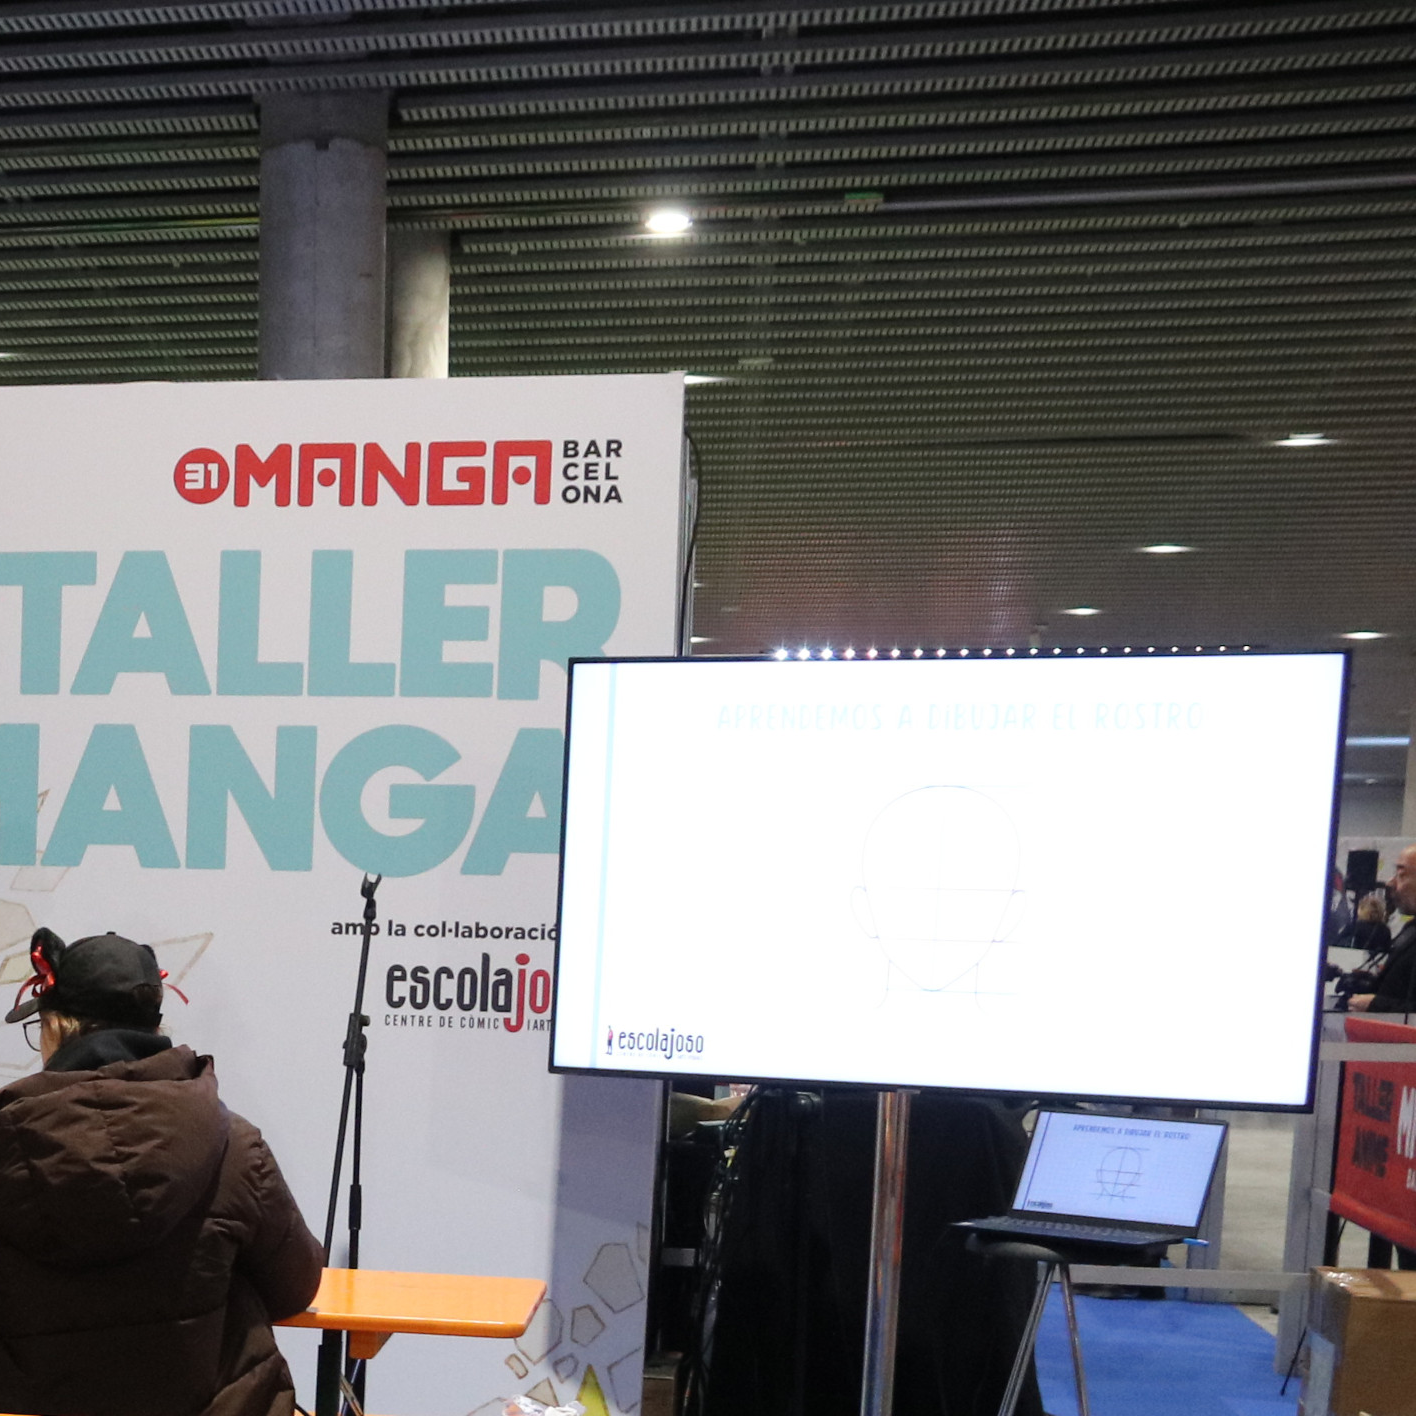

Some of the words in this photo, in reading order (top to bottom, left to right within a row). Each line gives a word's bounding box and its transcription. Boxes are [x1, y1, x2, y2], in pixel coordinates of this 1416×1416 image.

[562, 439, 623, 459] BAR
[233, 440, 553, 507] MANGA
[562, 461, 620, 481] CEL
[561, 485, 624, 504] ONA
[716, 703, 883, 730] APRENDEMOS
[896, 703, 913, 729] A
[1051, 702, 1078, 730] EL
[1094, 701, 1205, 730] ROSTRO
[387, 919, 407, 937] la
[385, 952, 551, 1033] escolajo
[384, 1014, 433, 1028] CENTRE
[438, 1016, 454, 1029] DE
[618, 1026, 705, 1060] escolajoso
